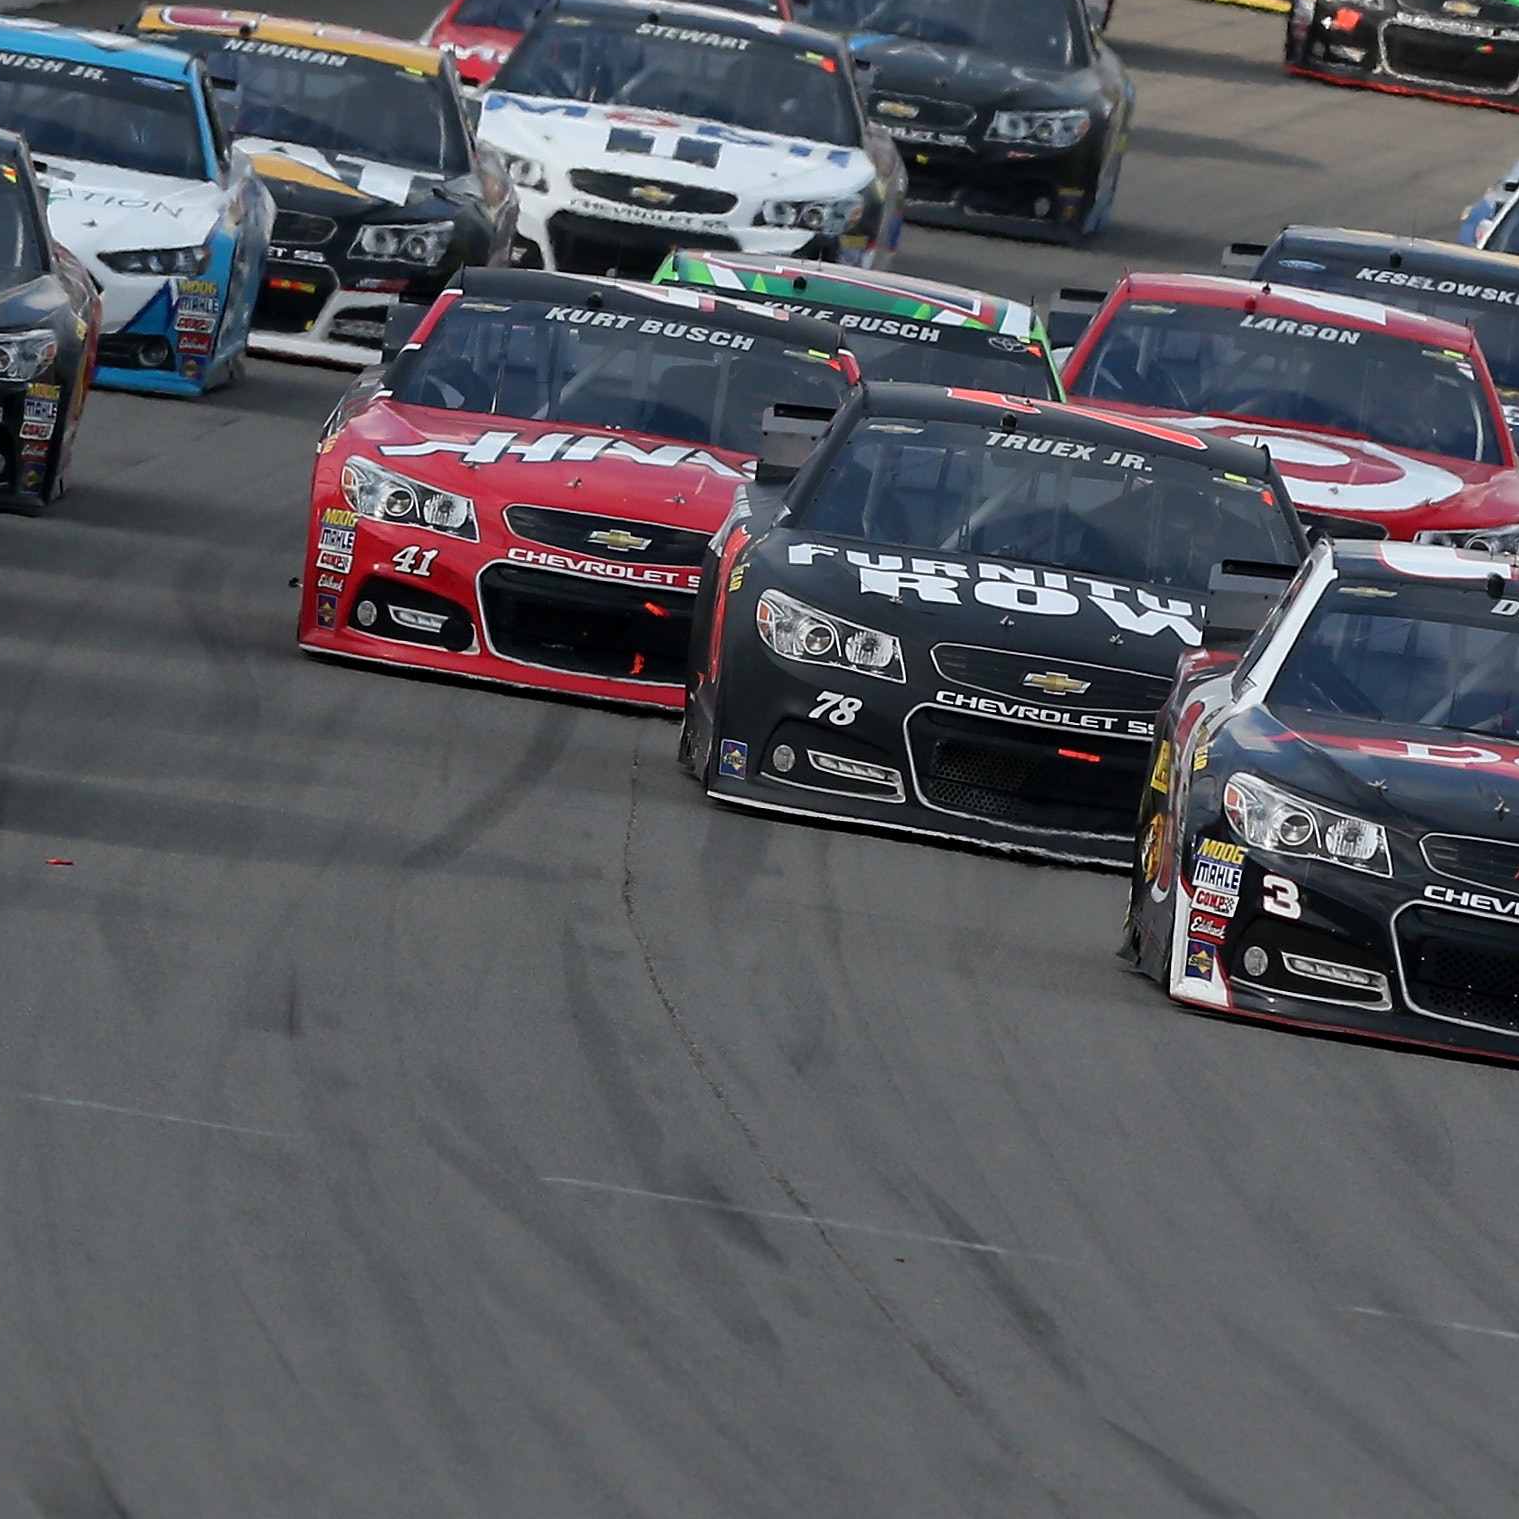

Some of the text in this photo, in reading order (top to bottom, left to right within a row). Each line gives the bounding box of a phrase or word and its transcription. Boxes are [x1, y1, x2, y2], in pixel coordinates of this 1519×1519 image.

[223, 39, 348, 68] NEWMAN
[635, 23, 751, 51] STEWART
[545, 306, 756, 352] KURT BUSCH
[838, 314, 941, 343] BUSCH
[1239, 314, 1362, 346] LARSON
[986, 430, 1153, 472] TRUEX JR.
[392, 544, 440, 578] 41
[508, 547, 679, 586] CHEVROLET
[787, 543, 1207, 618] FURNITU
[859, 567, 1205, 647] ROW
[807, 691, 865, 727] 78
[934, 690, 1119, 731] CHEVROLET
[1197, 837, 1247, 864] MOOG
[1195, 861, 1243, 892] MAHLE
[1195, 890, 1226, 908] COMP
[1262, 873, 1303, 921] 3
